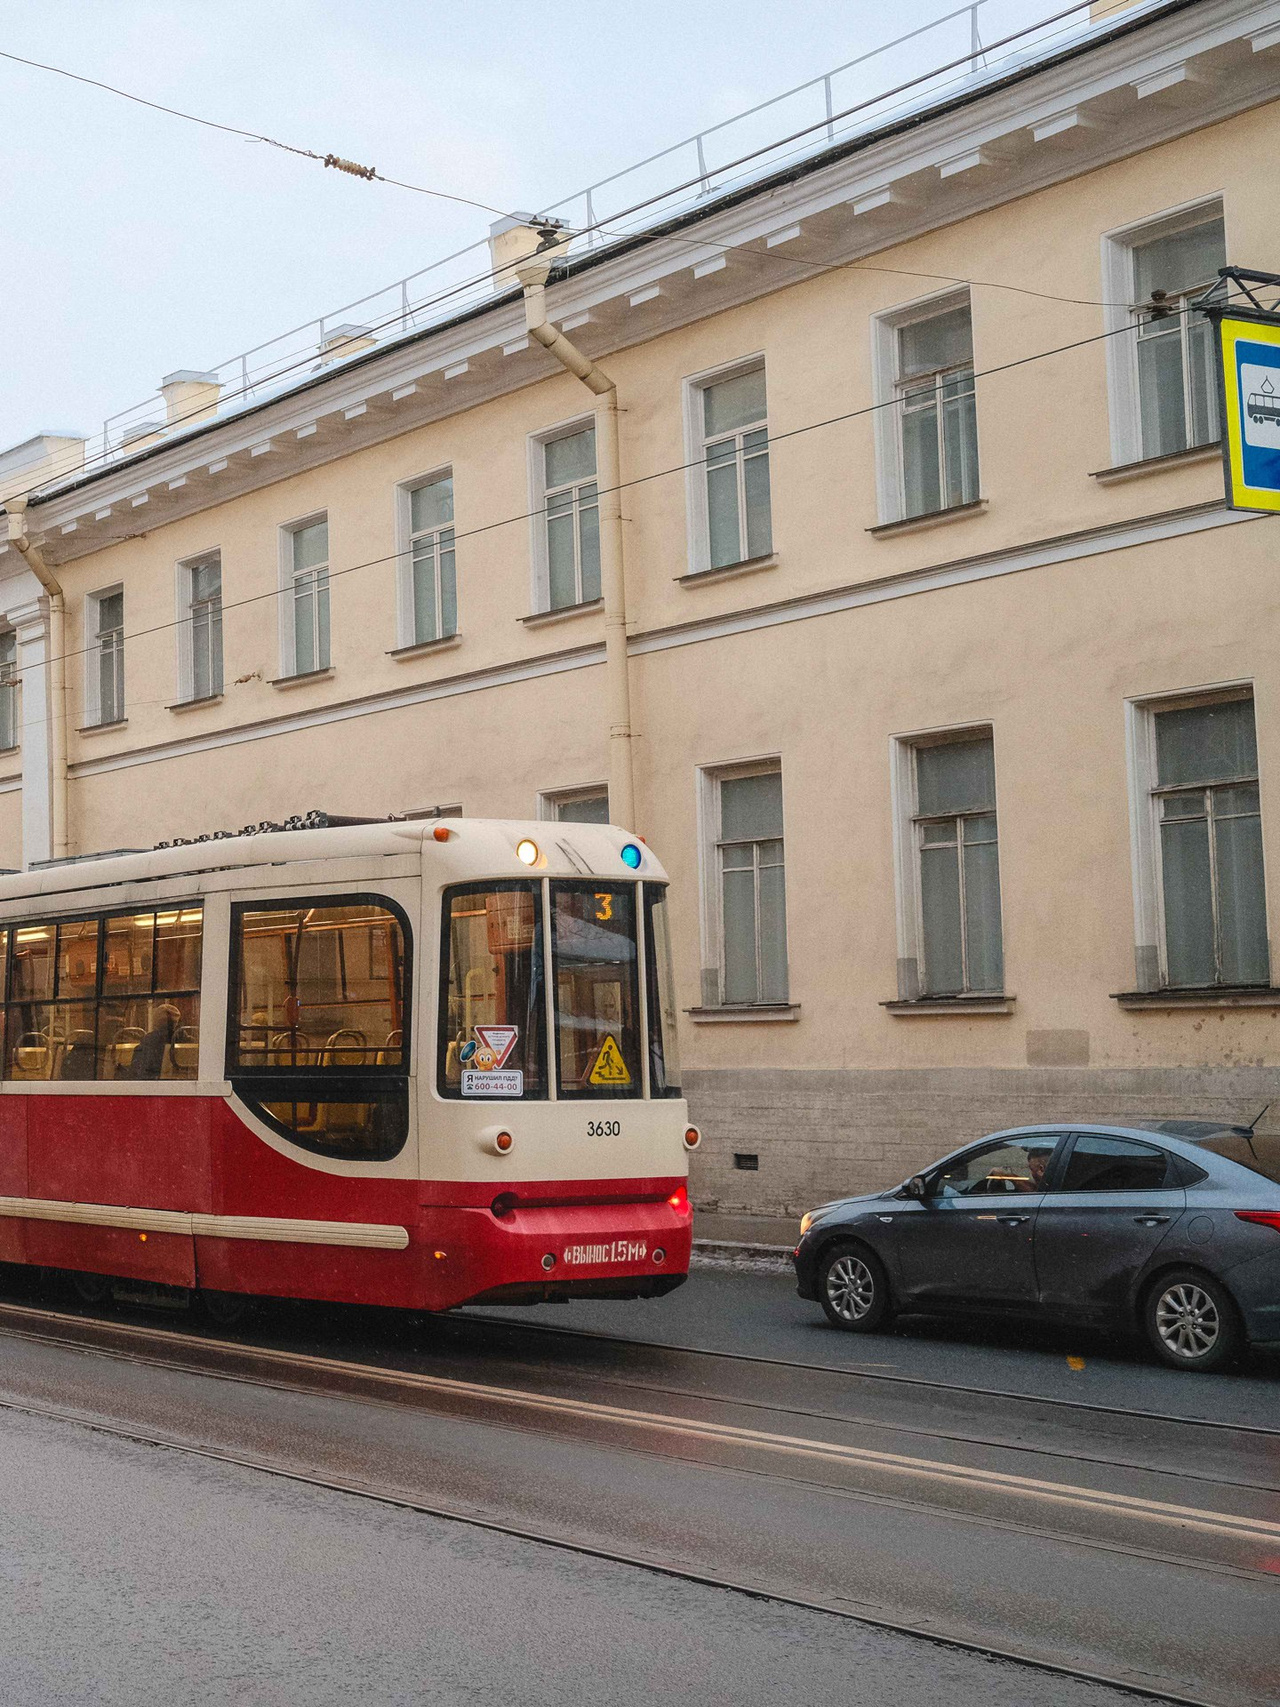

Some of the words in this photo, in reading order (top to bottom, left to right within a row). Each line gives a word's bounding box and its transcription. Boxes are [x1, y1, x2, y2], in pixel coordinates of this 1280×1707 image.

[594, 893, 612, 920] 3
[467, 1075, 474, 1083] Я
[475, 1083, 518, 1091] 600-44-00
[587, 1121, 620, 1136] 3630
[572, 1244, 609, 1264] ВЫНОС
